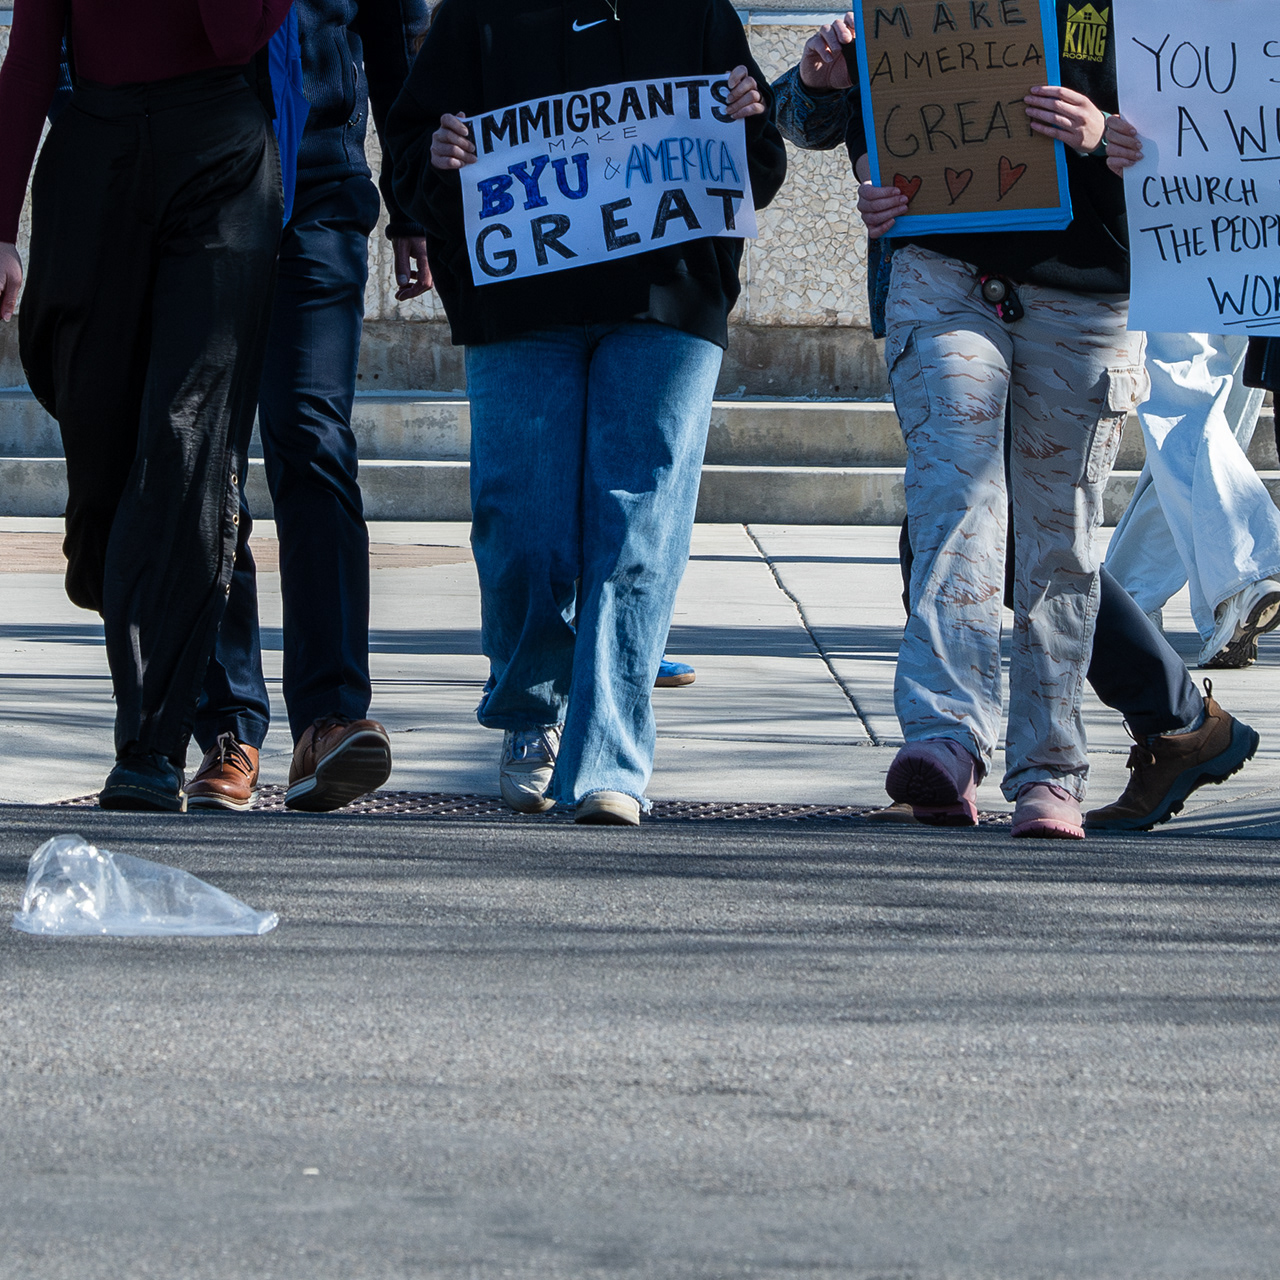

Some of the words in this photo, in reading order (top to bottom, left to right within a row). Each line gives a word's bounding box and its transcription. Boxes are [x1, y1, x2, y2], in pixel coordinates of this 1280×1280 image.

[1063, 52, 1103, 62] ROOFING
[1064, 21, 1107, 56] KING
[871, 41, 1043, 86] AMERICA
[1132, 33, 1237, 94] YOU
[549, 126, 638, 153] MAKE
[1177, 106, 1209, 157] A
[477, 153, 589, 219] BYU
[604, 157, 621, 180] &
[625, 137, 740, 188] AMERICA
[1142, 174, 1258, 208] CHURCH
[475, 187, 745, 277] GREAT
[1140, 223, 1207, 263] THE
